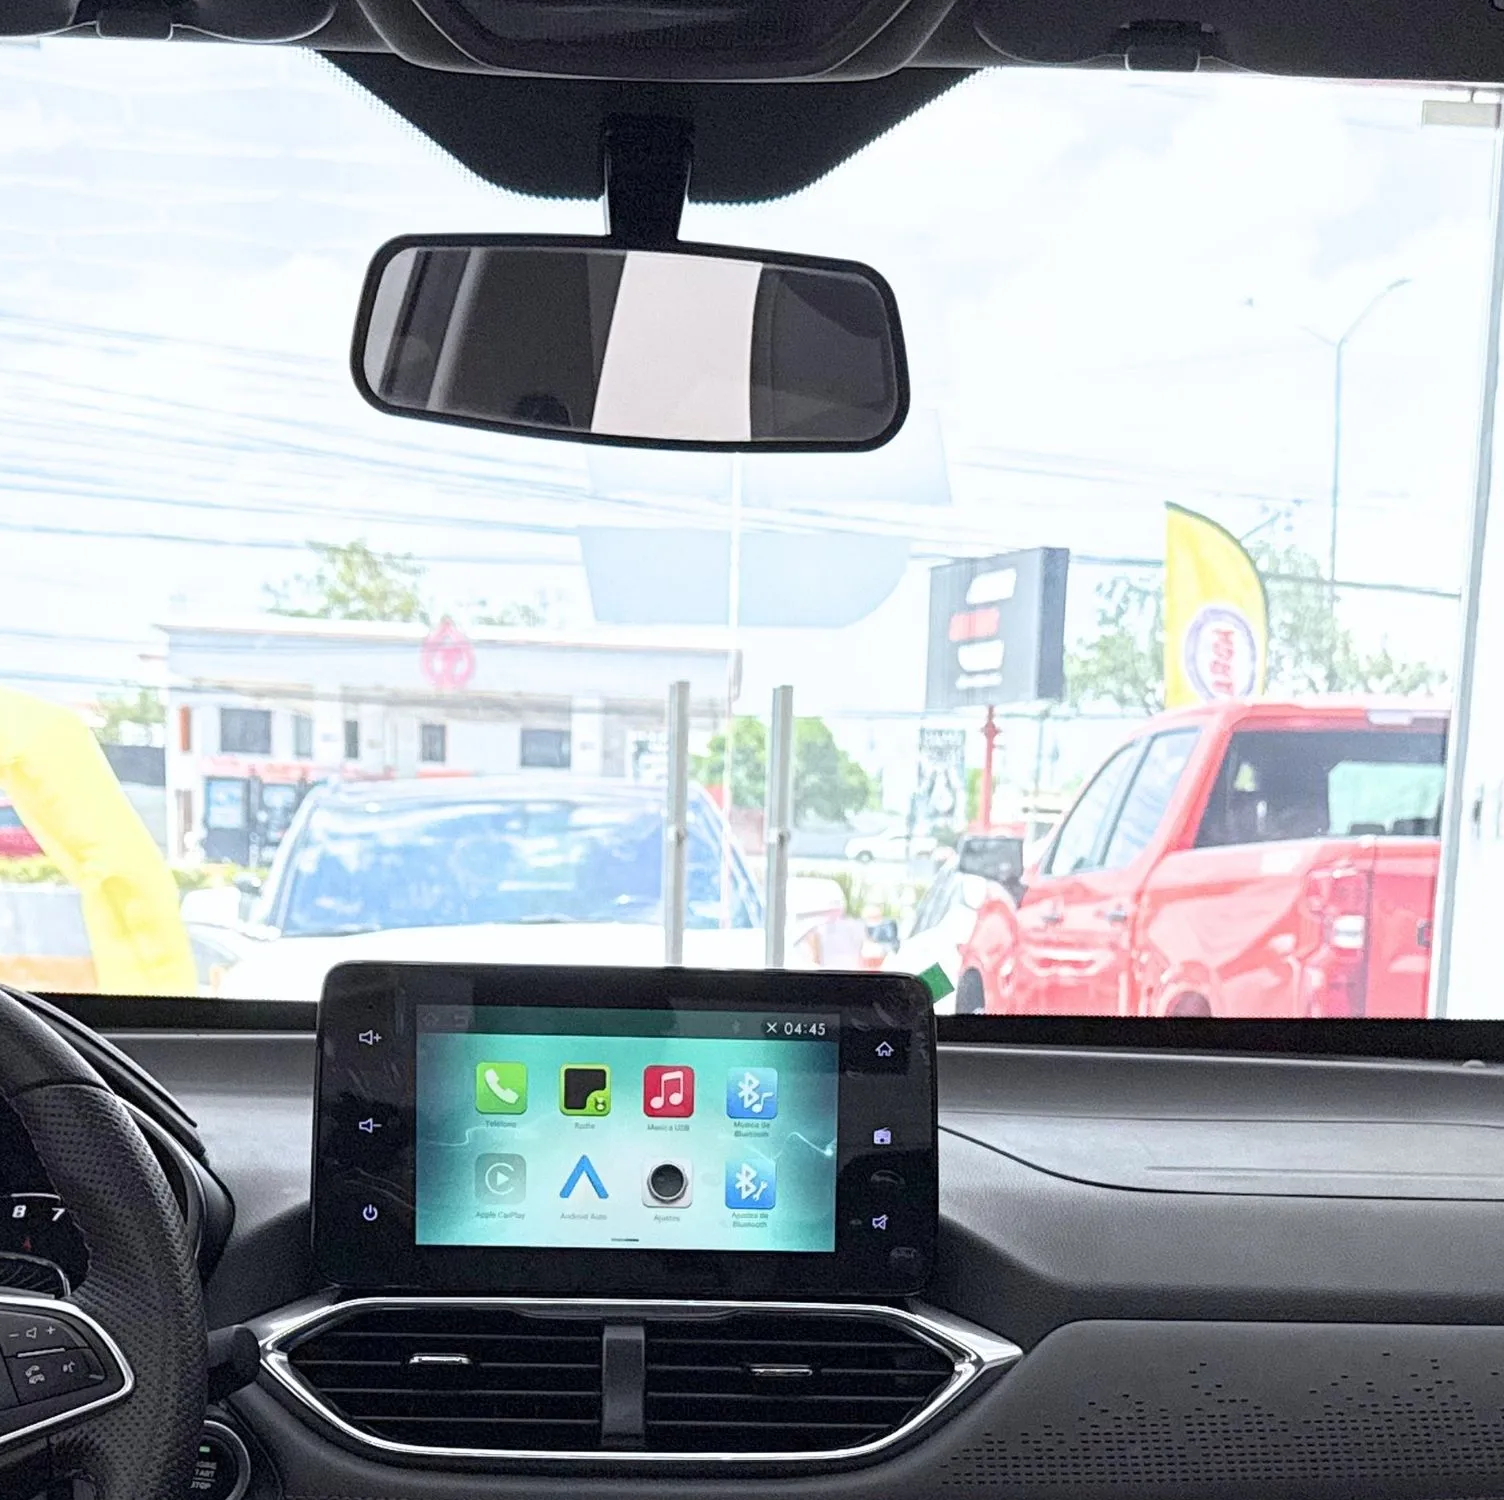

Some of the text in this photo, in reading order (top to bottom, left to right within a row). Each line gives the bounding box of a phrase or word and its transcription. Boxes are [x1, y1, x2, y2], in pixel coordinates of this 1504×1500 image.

[783, 1022, 826, 1036] 04:45
[12, 1205, 26, 1218] 8
[52, 1207, 65, 1221] 7
